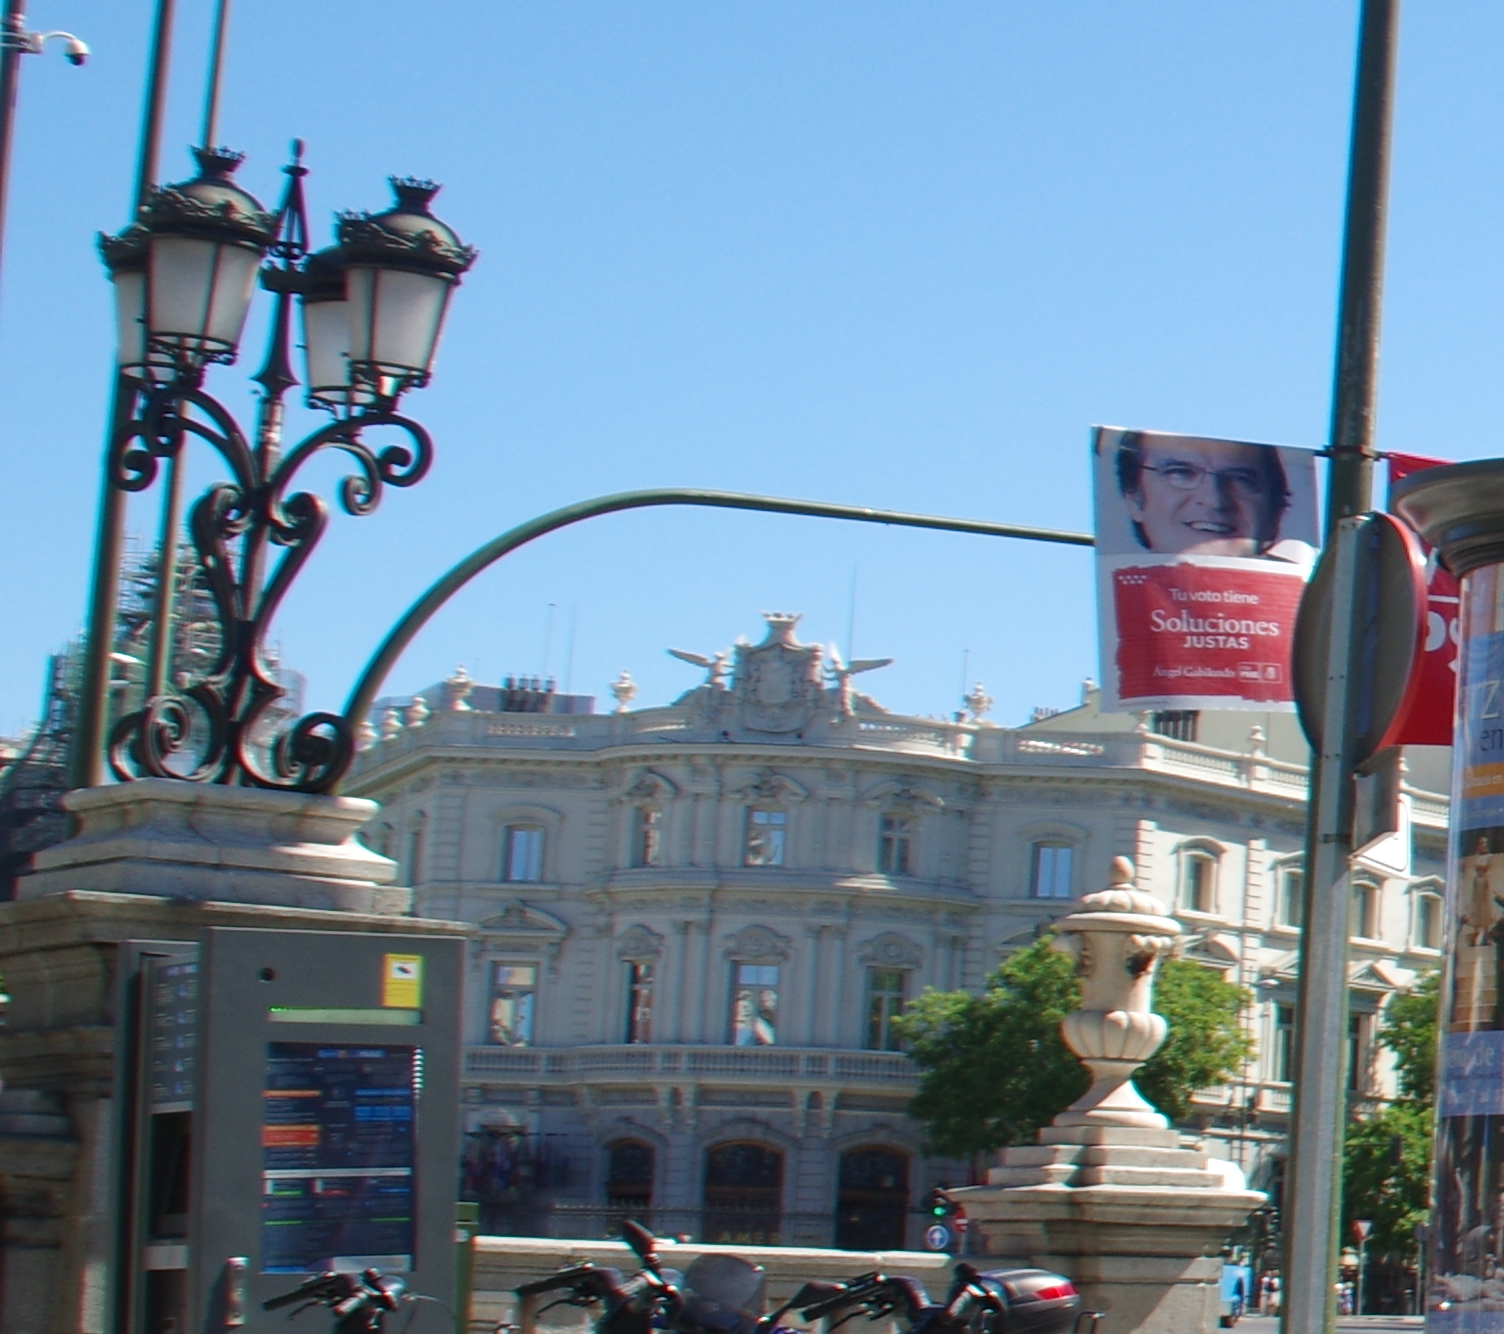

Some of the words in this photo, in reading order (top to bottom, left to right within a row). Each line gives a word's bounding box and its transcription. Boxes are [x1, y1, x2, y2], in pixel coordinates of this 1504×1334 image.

[1169, 588, 1188, 601] Tu
[1190, 590, 1221, 603] voto
[1223, 591, 1259, 605] tiene
[1151, 609, 1280, 637] Soluciones
[1183, 635, 1250, 650] JUSTAS
